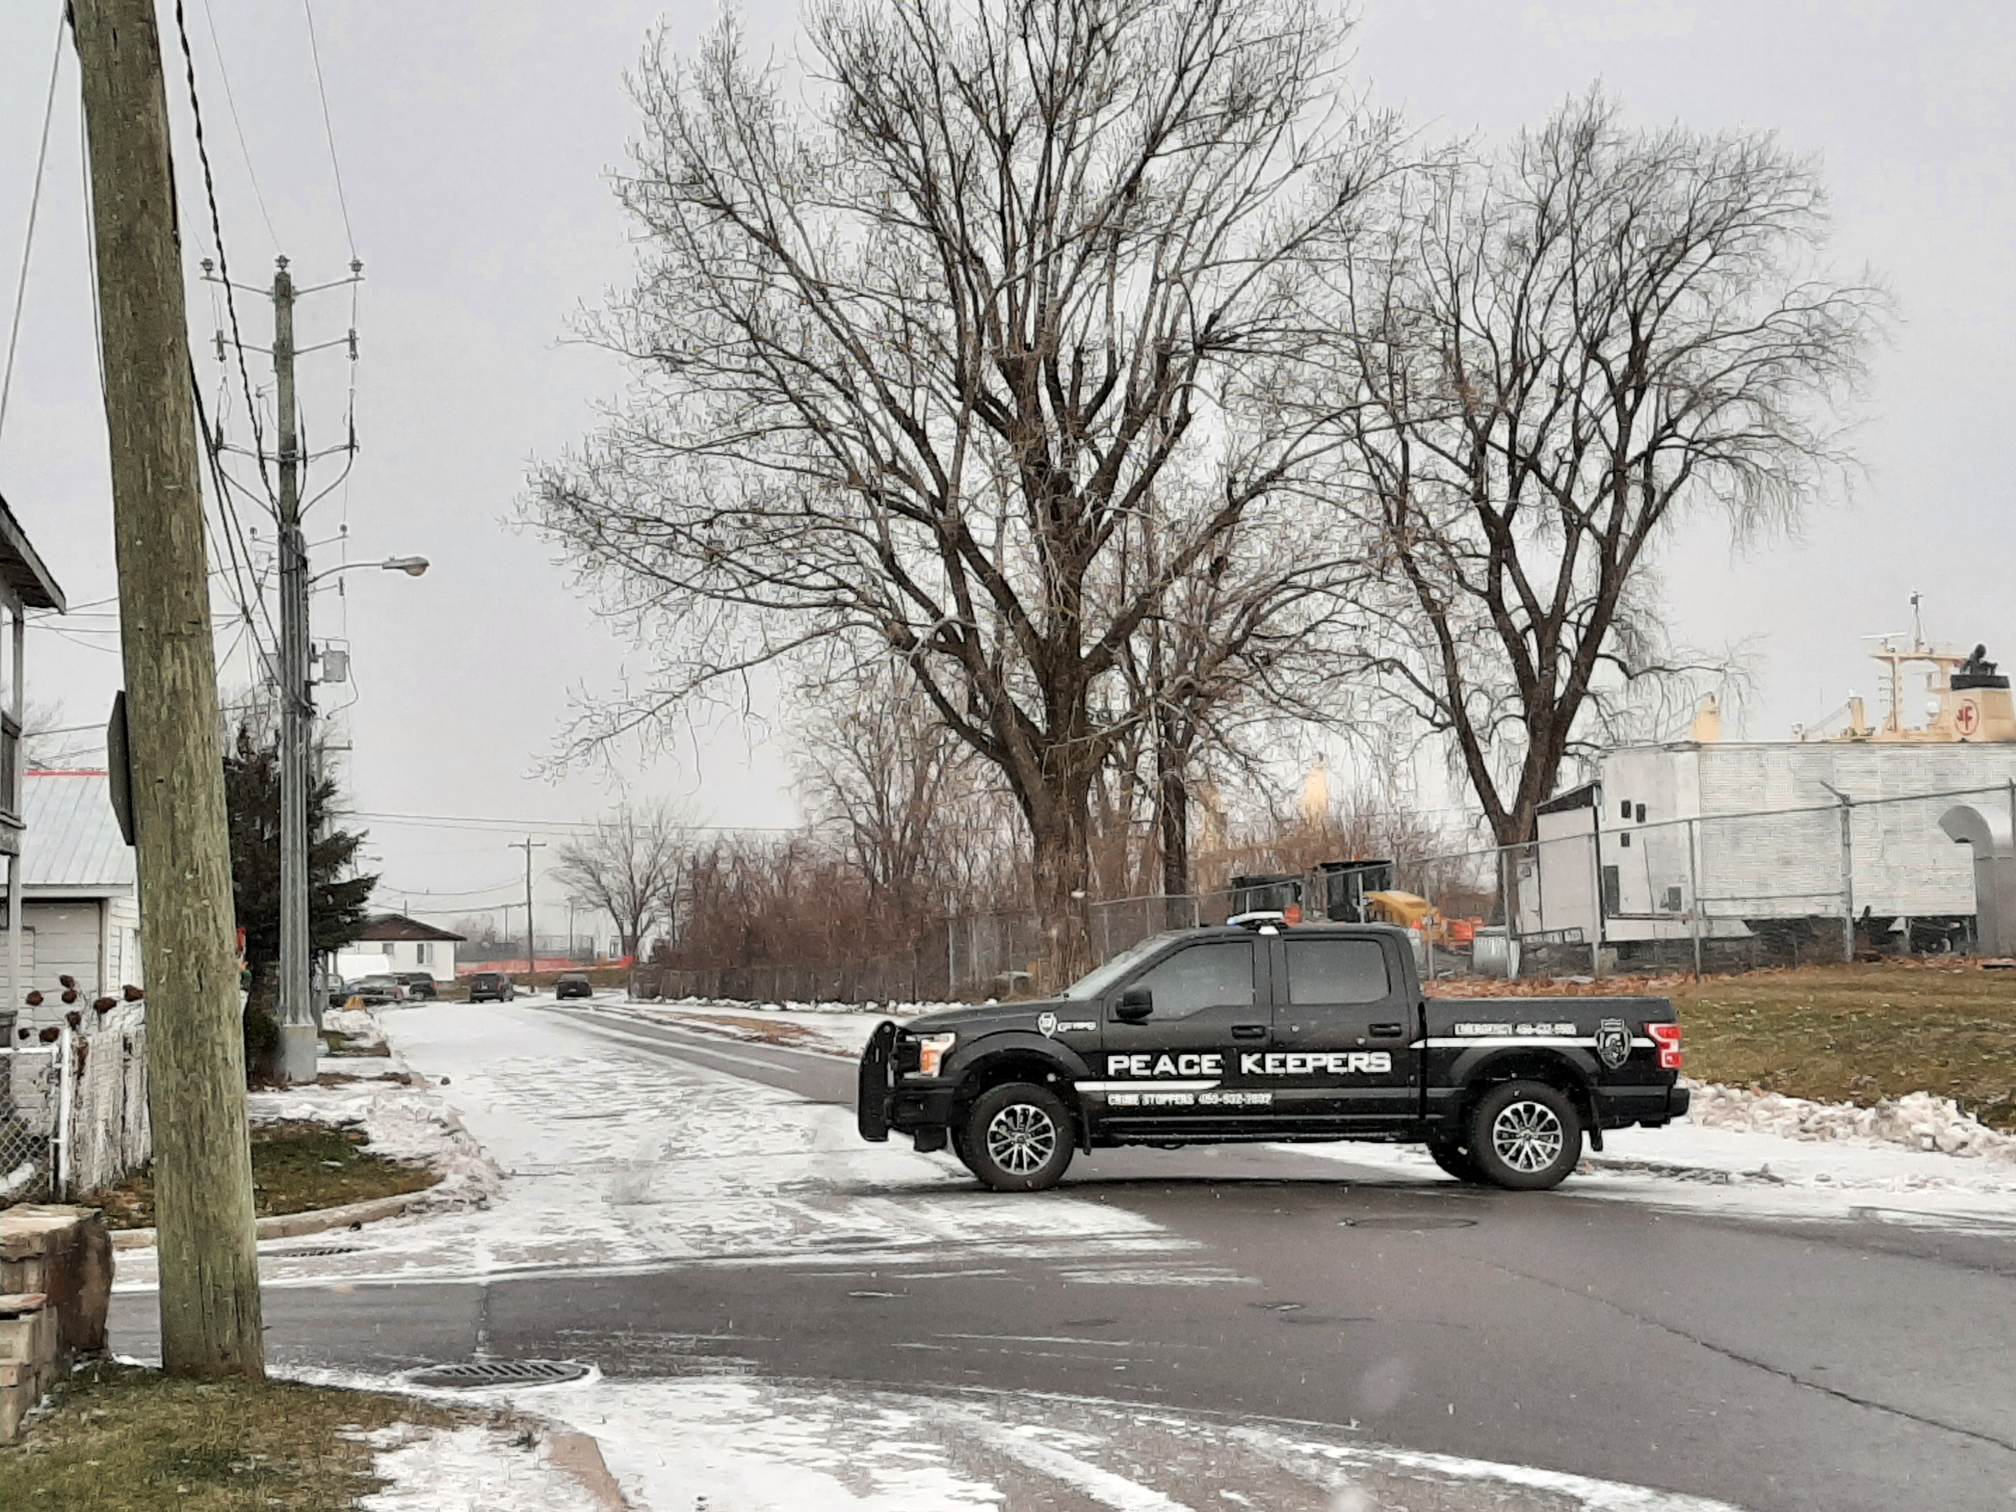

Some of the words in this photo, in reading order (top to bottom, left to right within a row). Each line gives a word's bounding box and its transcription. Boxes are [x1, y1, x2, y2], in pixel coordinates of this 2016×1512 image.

[1107, 1054, 1223, 1076] PEACE
[1241, 1052, 1392, 1075] KEEPERS
[1142, 1093, 1195, 1105] STOPPERS
